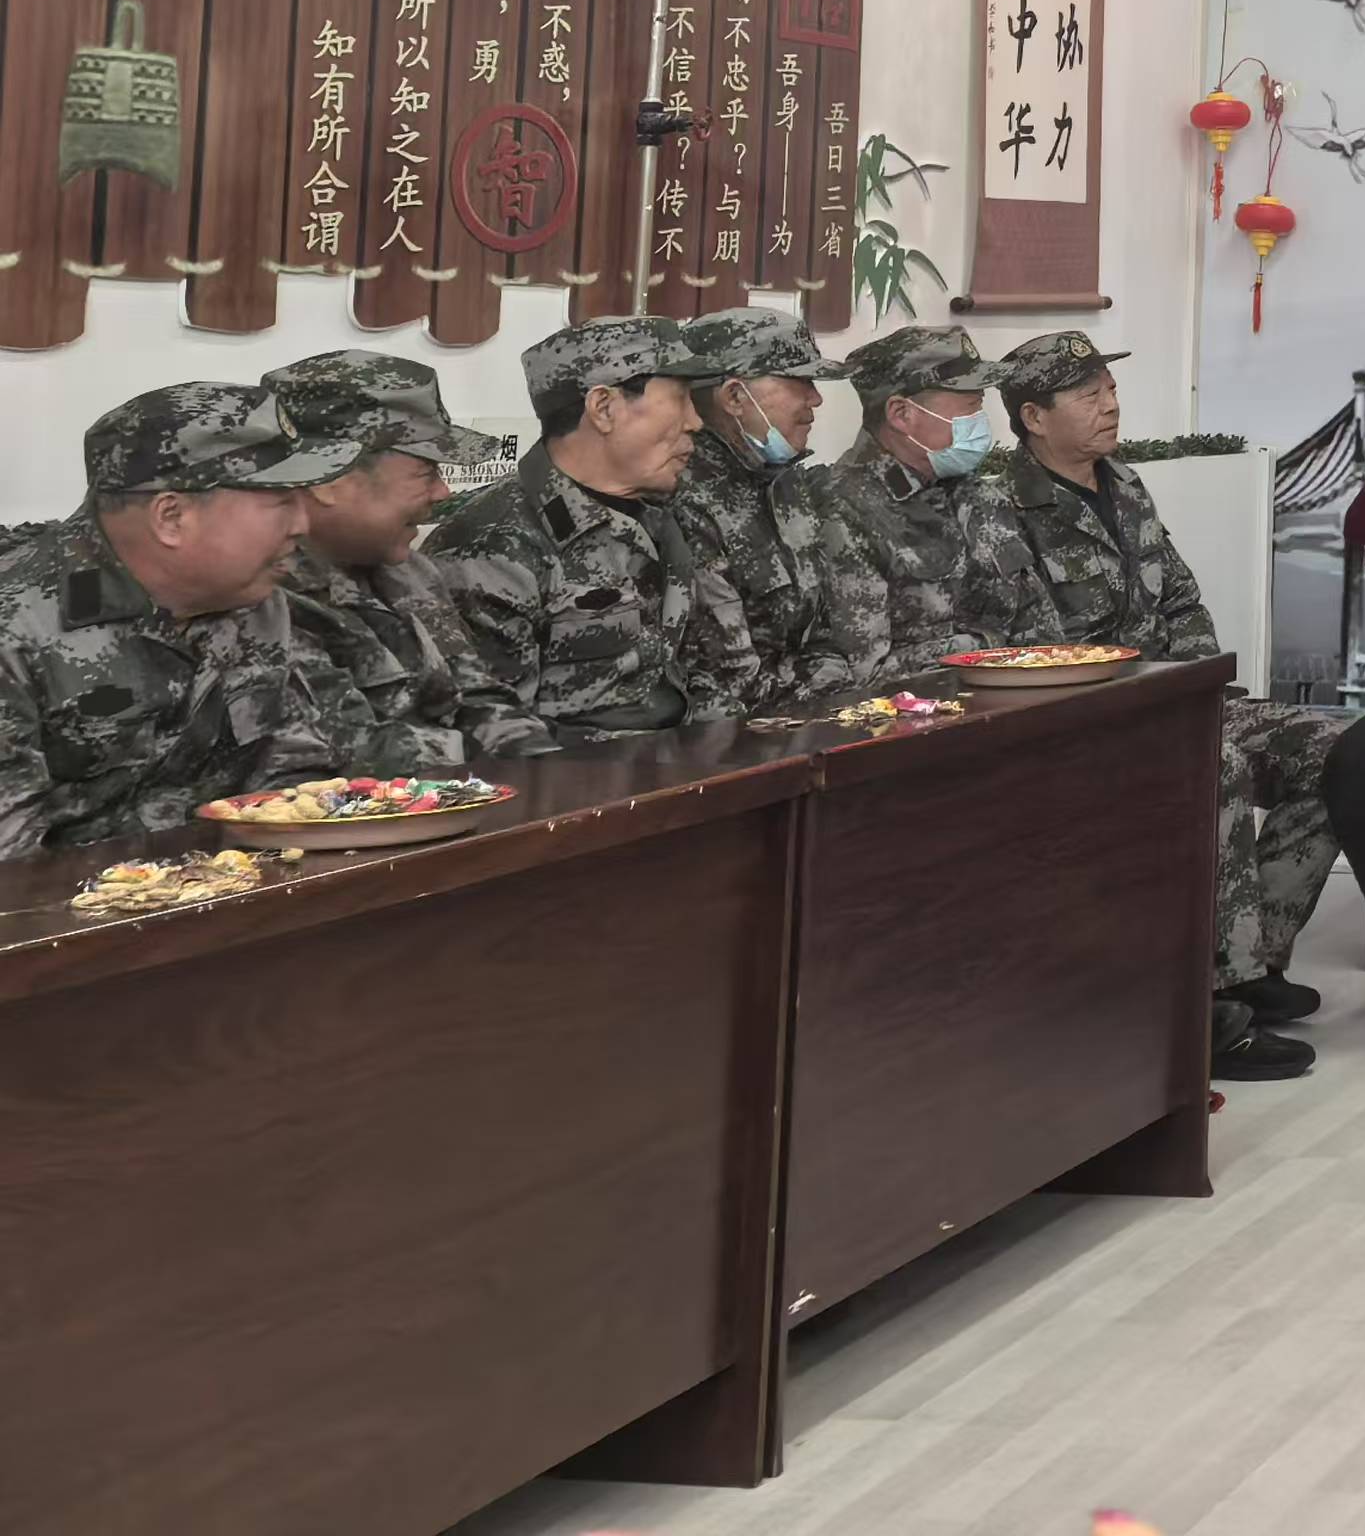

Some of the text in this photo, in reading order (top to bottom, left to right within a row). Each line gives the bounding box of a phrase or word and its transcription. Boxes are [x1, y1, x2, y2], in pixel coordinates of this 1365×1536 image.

[818, 102, 850, 259] 吾日三省
[461, 463, 517, 477] SMOKING
